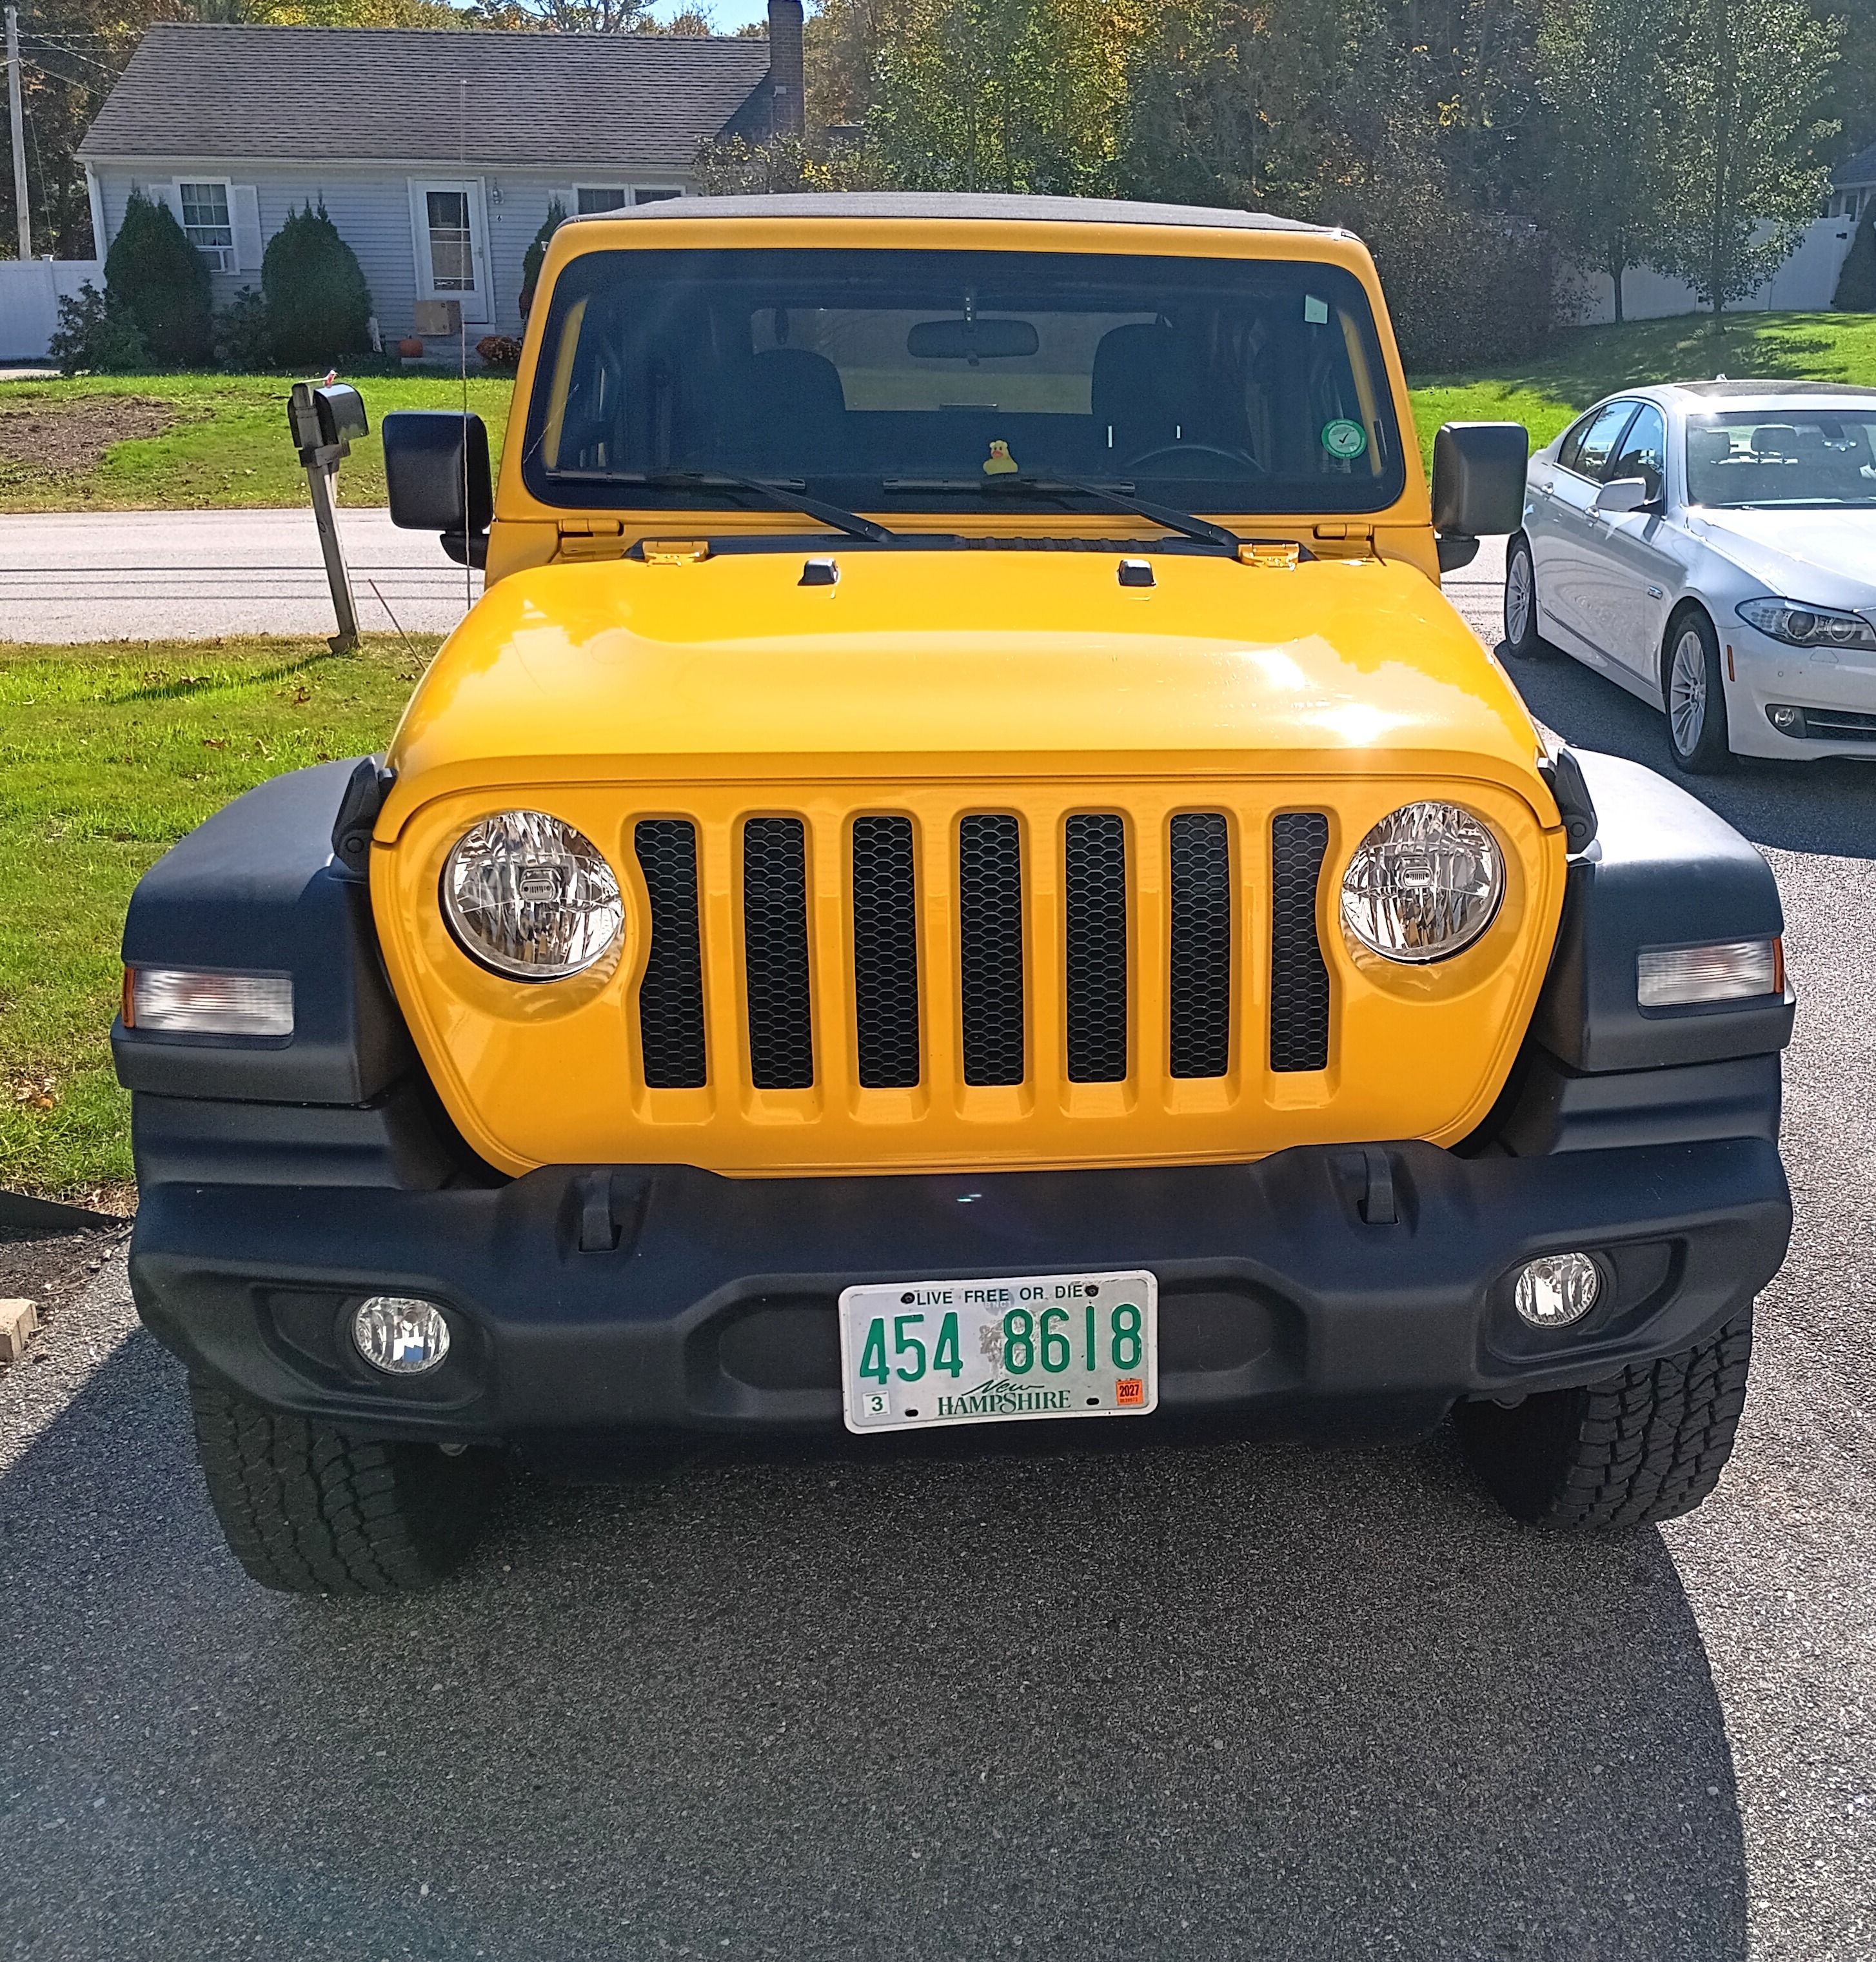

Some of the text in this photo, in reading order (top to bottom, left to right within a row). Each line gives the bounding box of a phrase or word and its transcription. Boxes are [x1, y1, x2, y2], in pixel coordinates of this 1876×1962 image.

[916, 1285, 1083, 1305] LIVE FREE OR DIE
[860, 1303, 1142, 1385] 454 8618
[961, 1378, 1045, 1396] New
[1119, 1383, 1140, 1397] 2027
[871, 1396, 883, 1412] 3
[938, 1390, 1071, 1416] HAMPSHIRE
